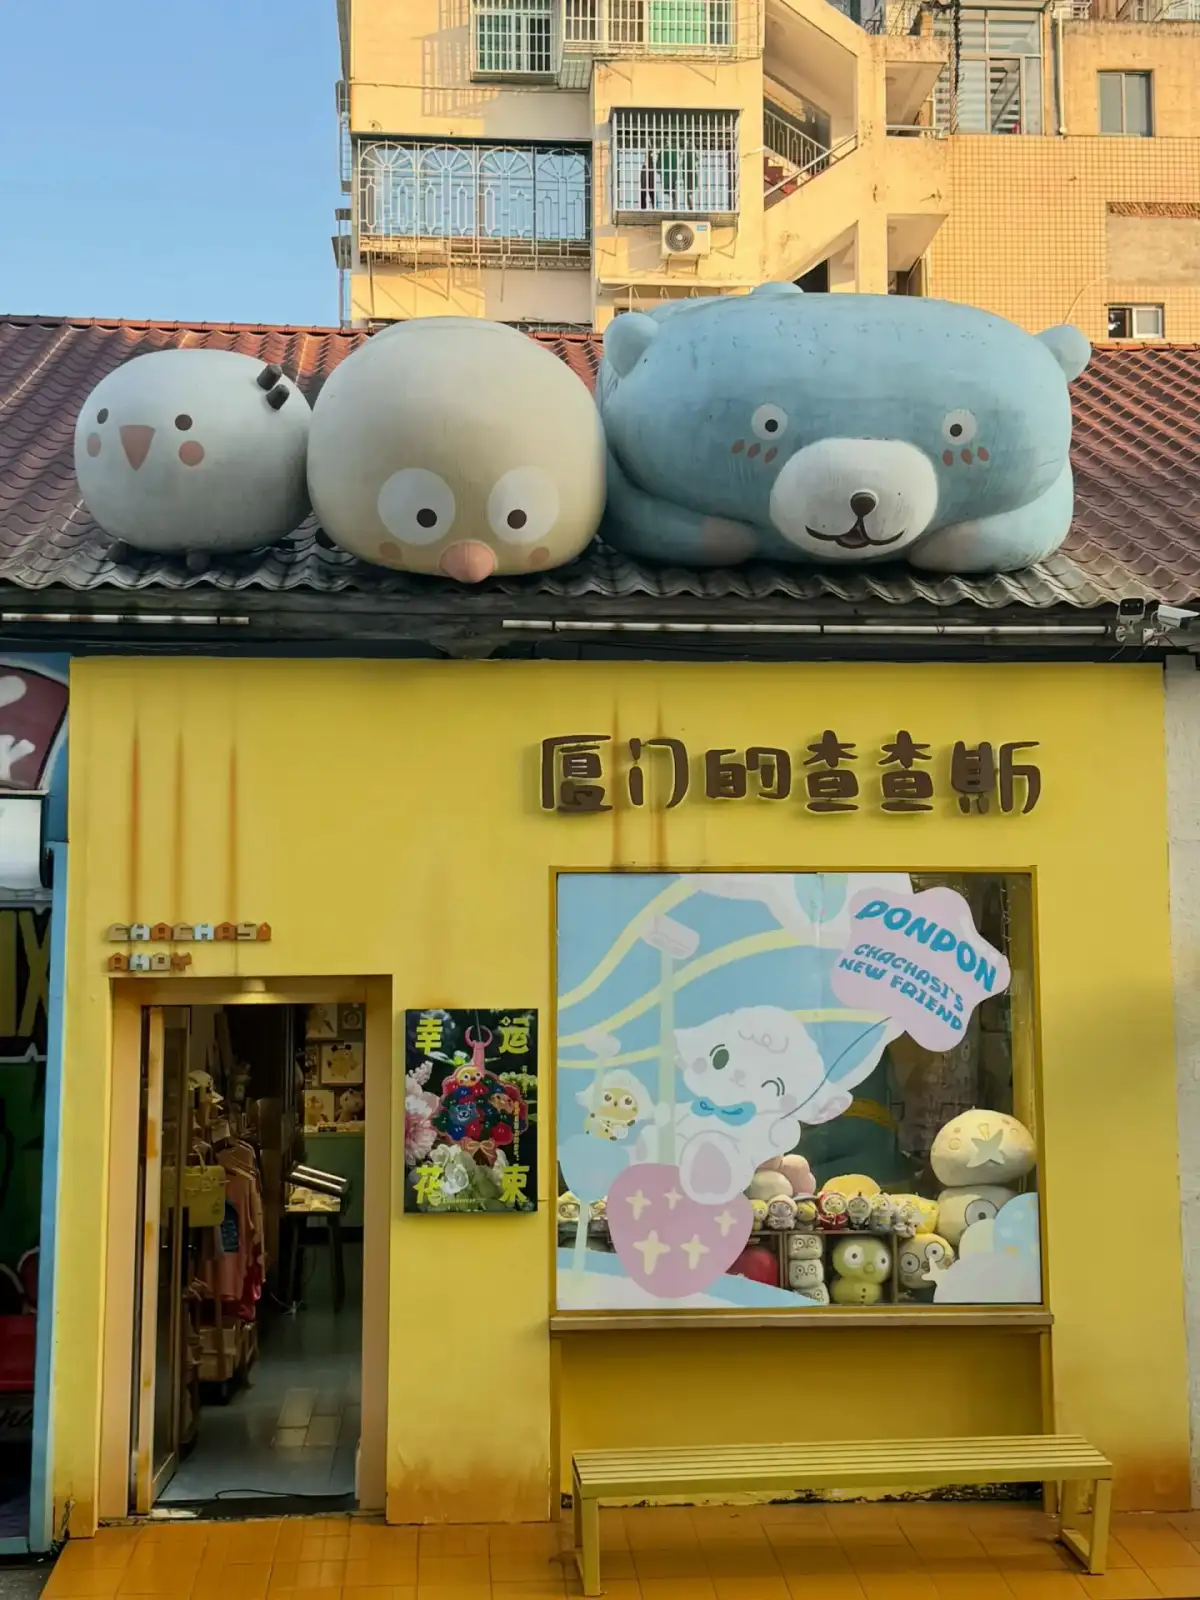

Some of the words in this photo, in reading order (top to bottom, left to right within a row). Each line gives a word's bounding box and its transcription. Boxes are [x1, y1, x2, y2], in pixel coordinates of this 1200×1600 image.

[541, 730, 1041, 814] 厦门的查查斯
[854, 943, 963, 1012] CHACHASI'S
[855, 901, 996, 991] PONDON
[838, 958, 887, 980] NEW
[890, 976, 962, 1030] FRIEND
[415, 1018, 442, 1055] 幸
[498, 1017, 529, 1054] 运
[413, 1166, 443, 1206] 花
[499, 1164, 529, 1203] 束
